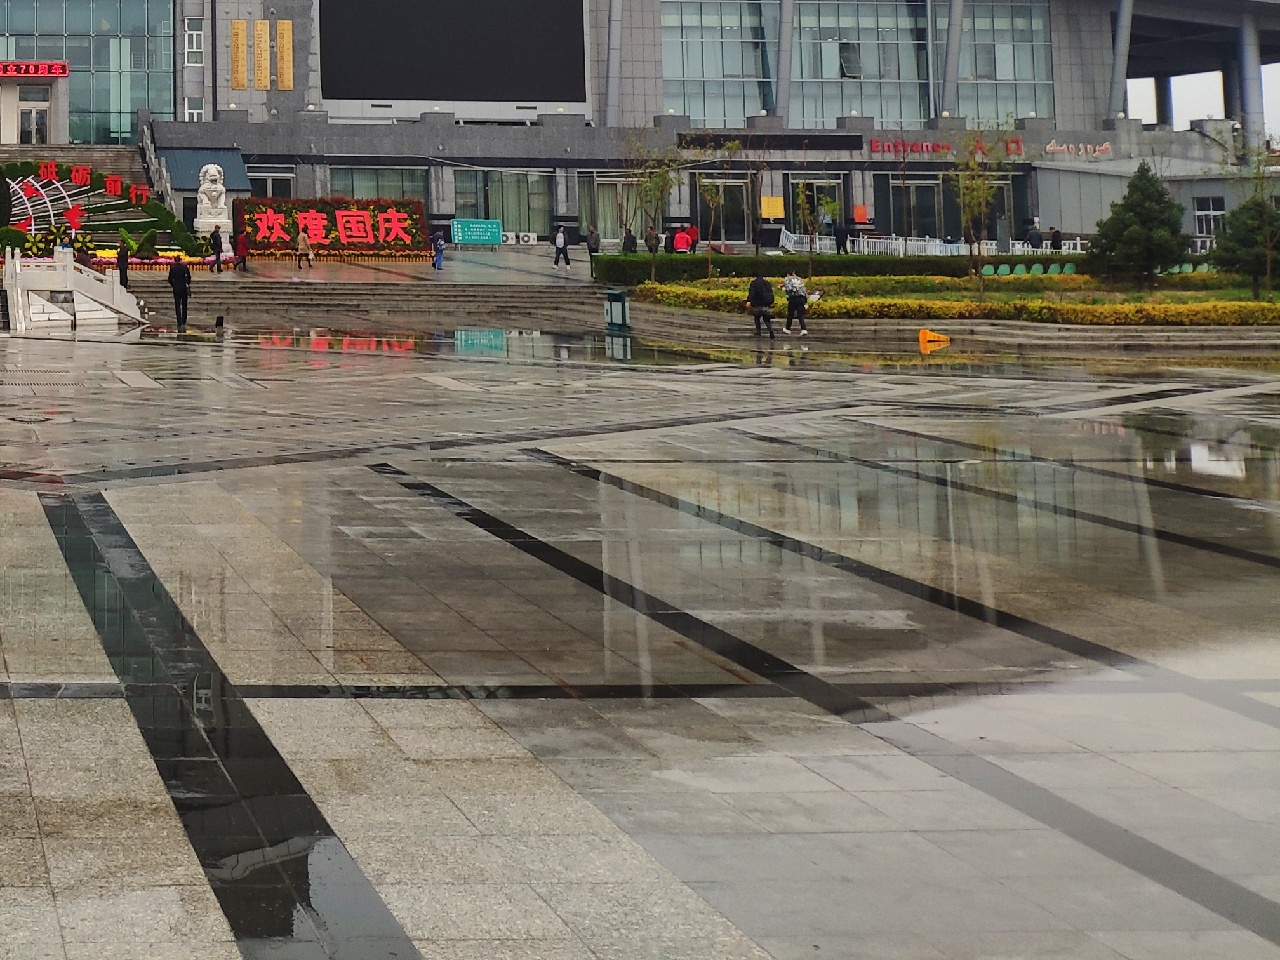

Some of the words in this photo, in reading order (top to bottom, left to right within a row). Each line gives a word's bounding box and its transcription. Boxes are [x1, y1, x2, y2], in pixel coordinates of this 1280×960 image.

[974, 137, 1023, 156] 入口
[39, 161, 149, 205] 砥砺前行
[255, 209, 412, 244] 欢度国庆
